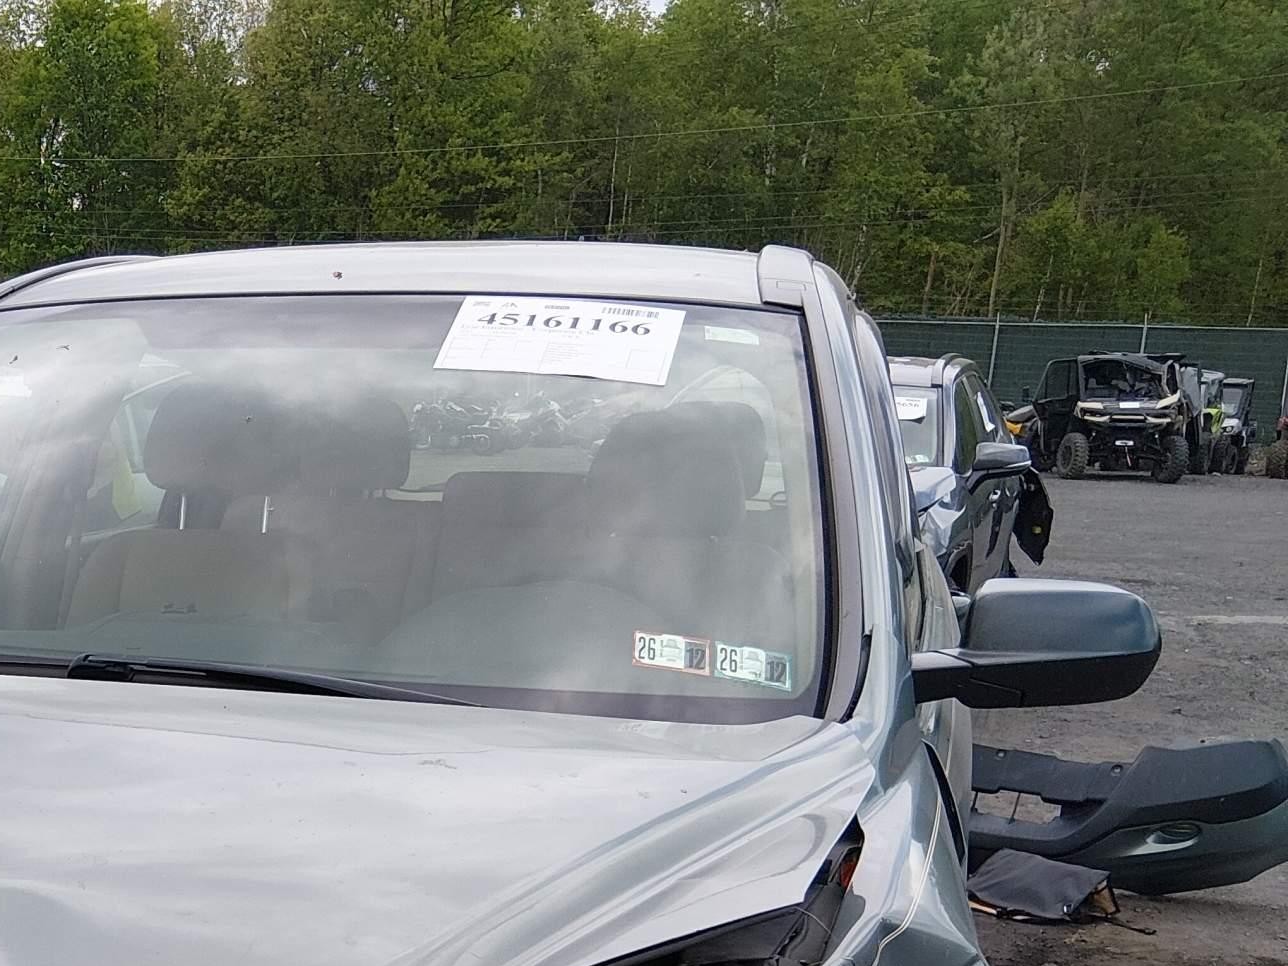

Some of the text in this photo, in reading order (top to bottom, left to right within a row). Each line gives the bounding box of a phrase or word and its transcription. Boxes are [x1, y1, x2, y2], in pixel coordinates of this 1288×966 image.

[477, 312, 651, 336] 45161166
[638, 636, 706, 670] 26 12
[719, 647, 787, 683] 26 12
